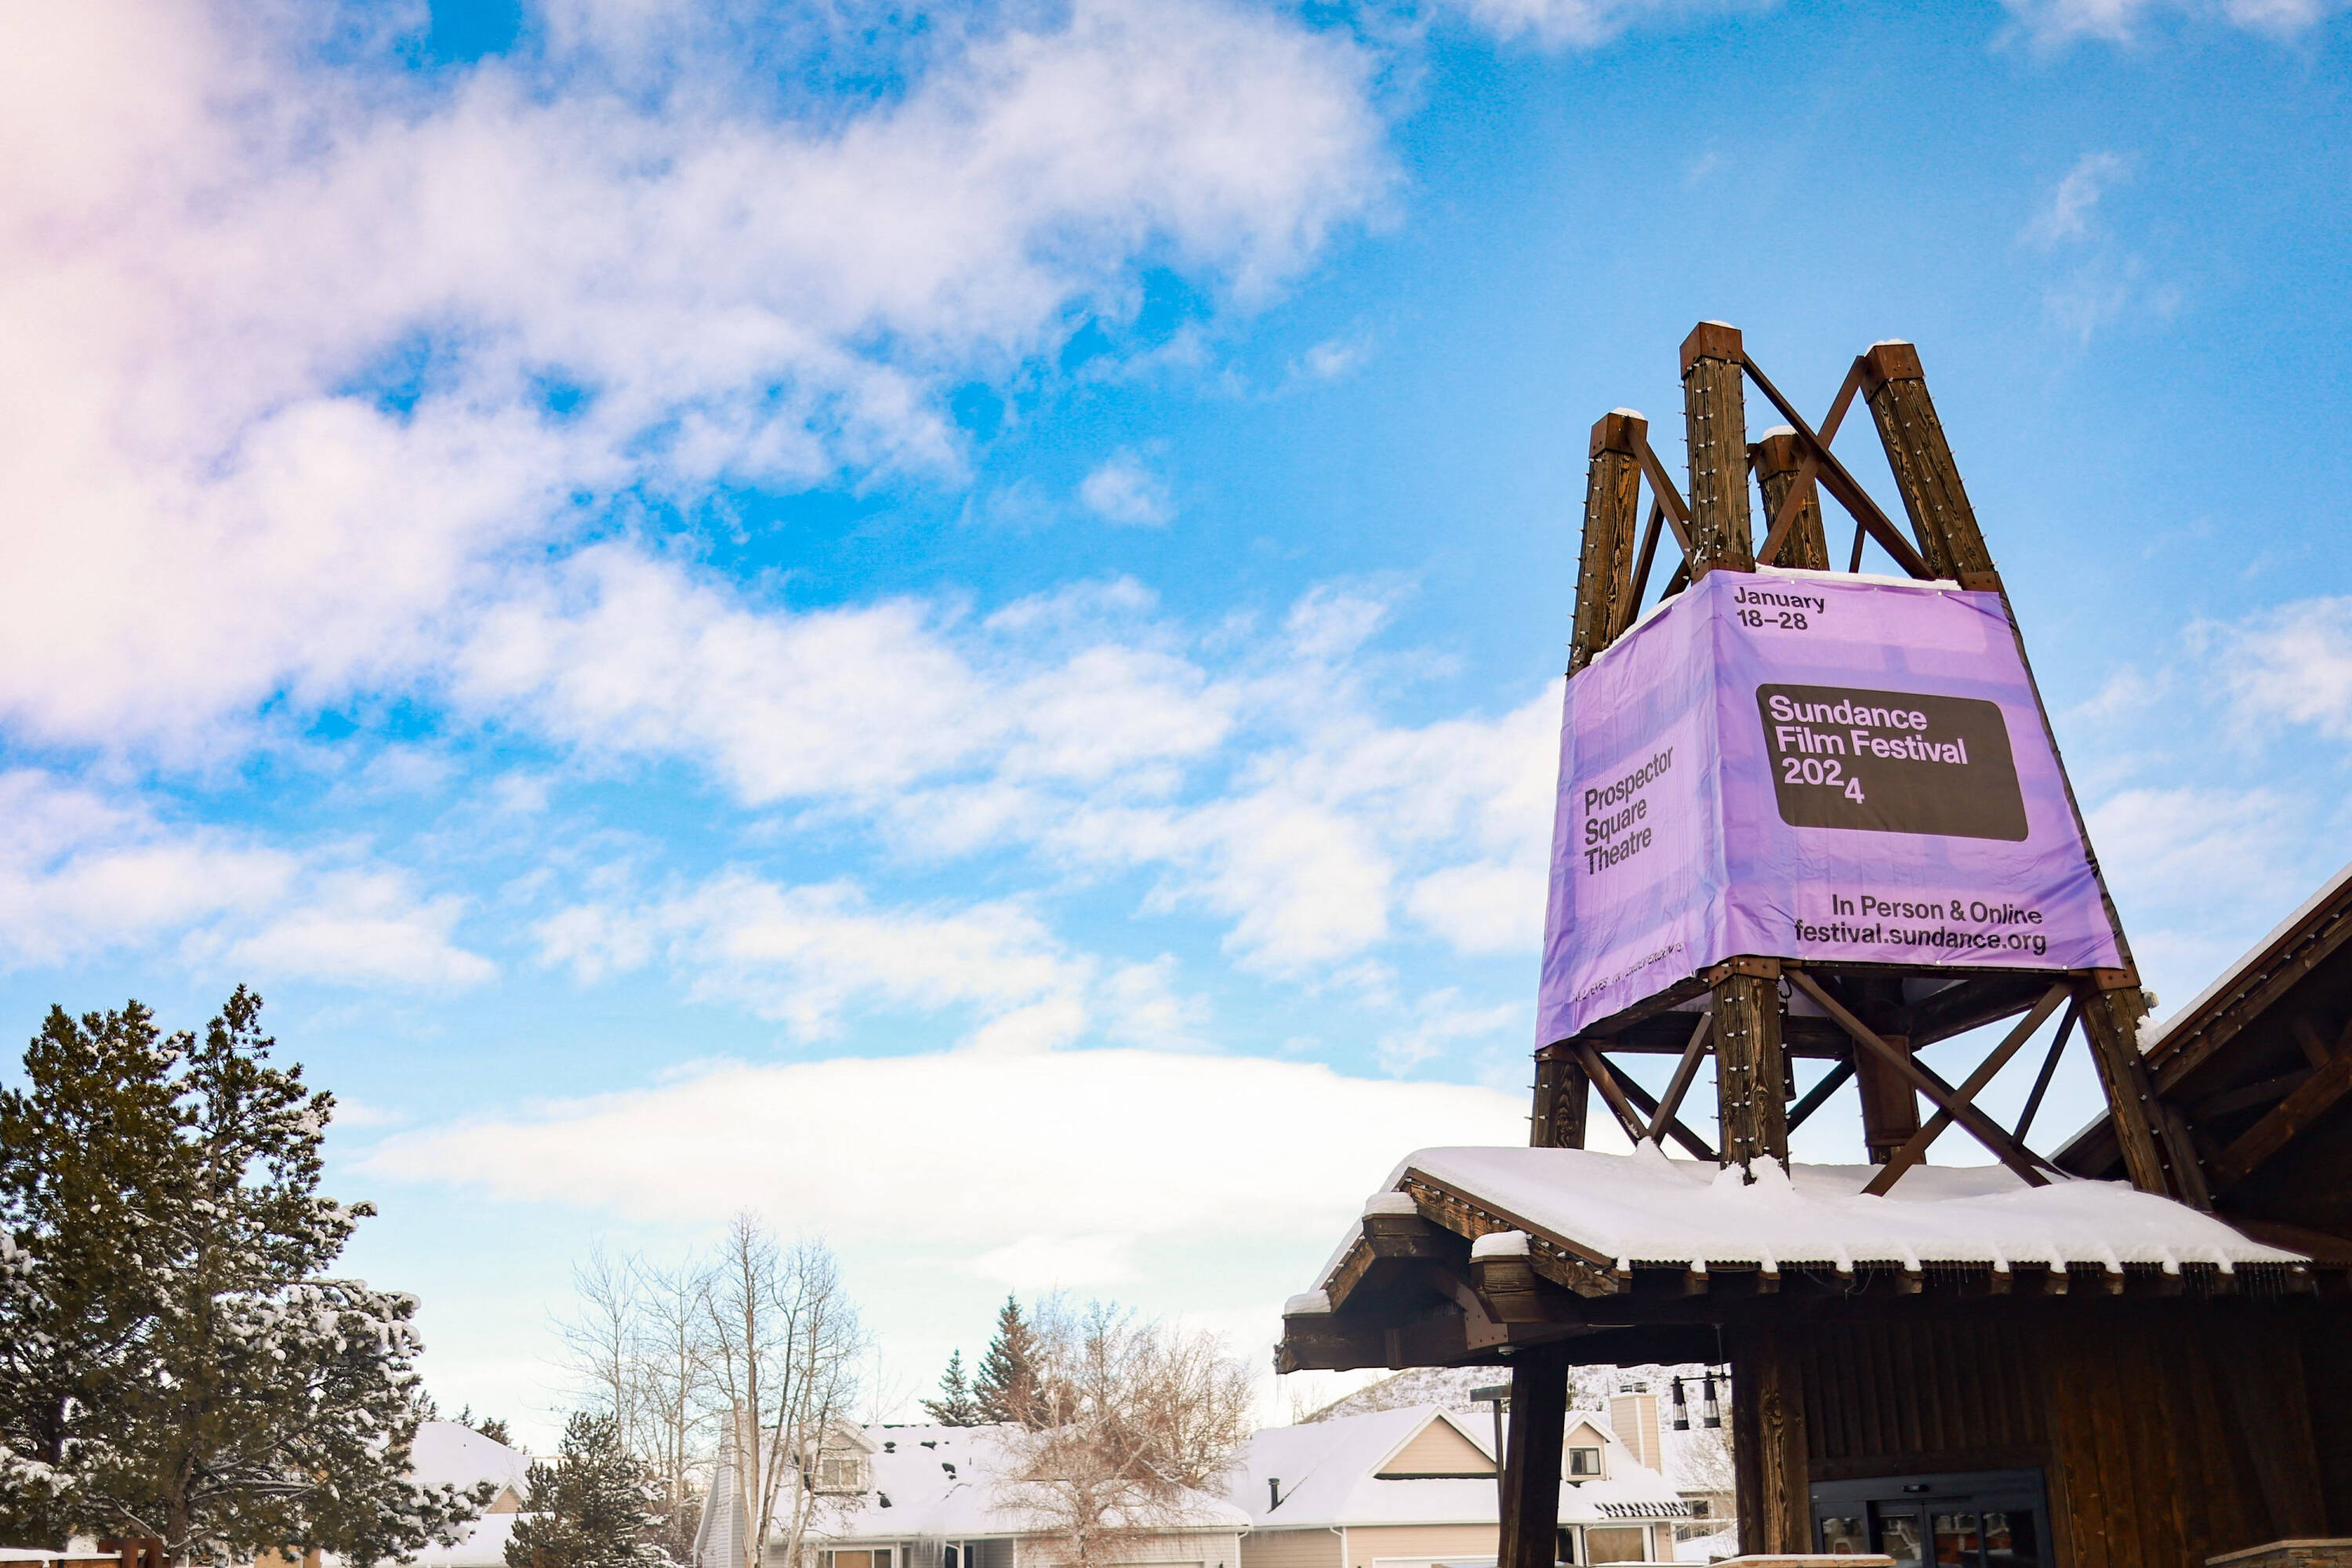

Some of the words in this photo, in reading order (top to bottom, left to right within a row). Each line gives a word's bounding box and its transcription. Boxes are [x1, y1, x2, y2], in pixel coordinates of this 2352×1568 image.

[1734, 586, 1824, 614] January
[1769, 695, 1927, 731] Sundance
[1775, 726, 1846, 755] Film
[1849, 730, 1968, 764] Festival
[1584, 746, 1673, 816] Prospector
[1784, 758, 1864, 804] 2024
[1584, 798, 1646, 845] Square
[1584, 827, 1652, 875] Theatre
[1832, 894, 1854, 916] In
[1860, 895, 1944, 920] Person
[1949, 899, 1966, 922] &
[1969, 901, 2042, 925] Online
[1795, 920, 2046, 956] festival.sundance.org
